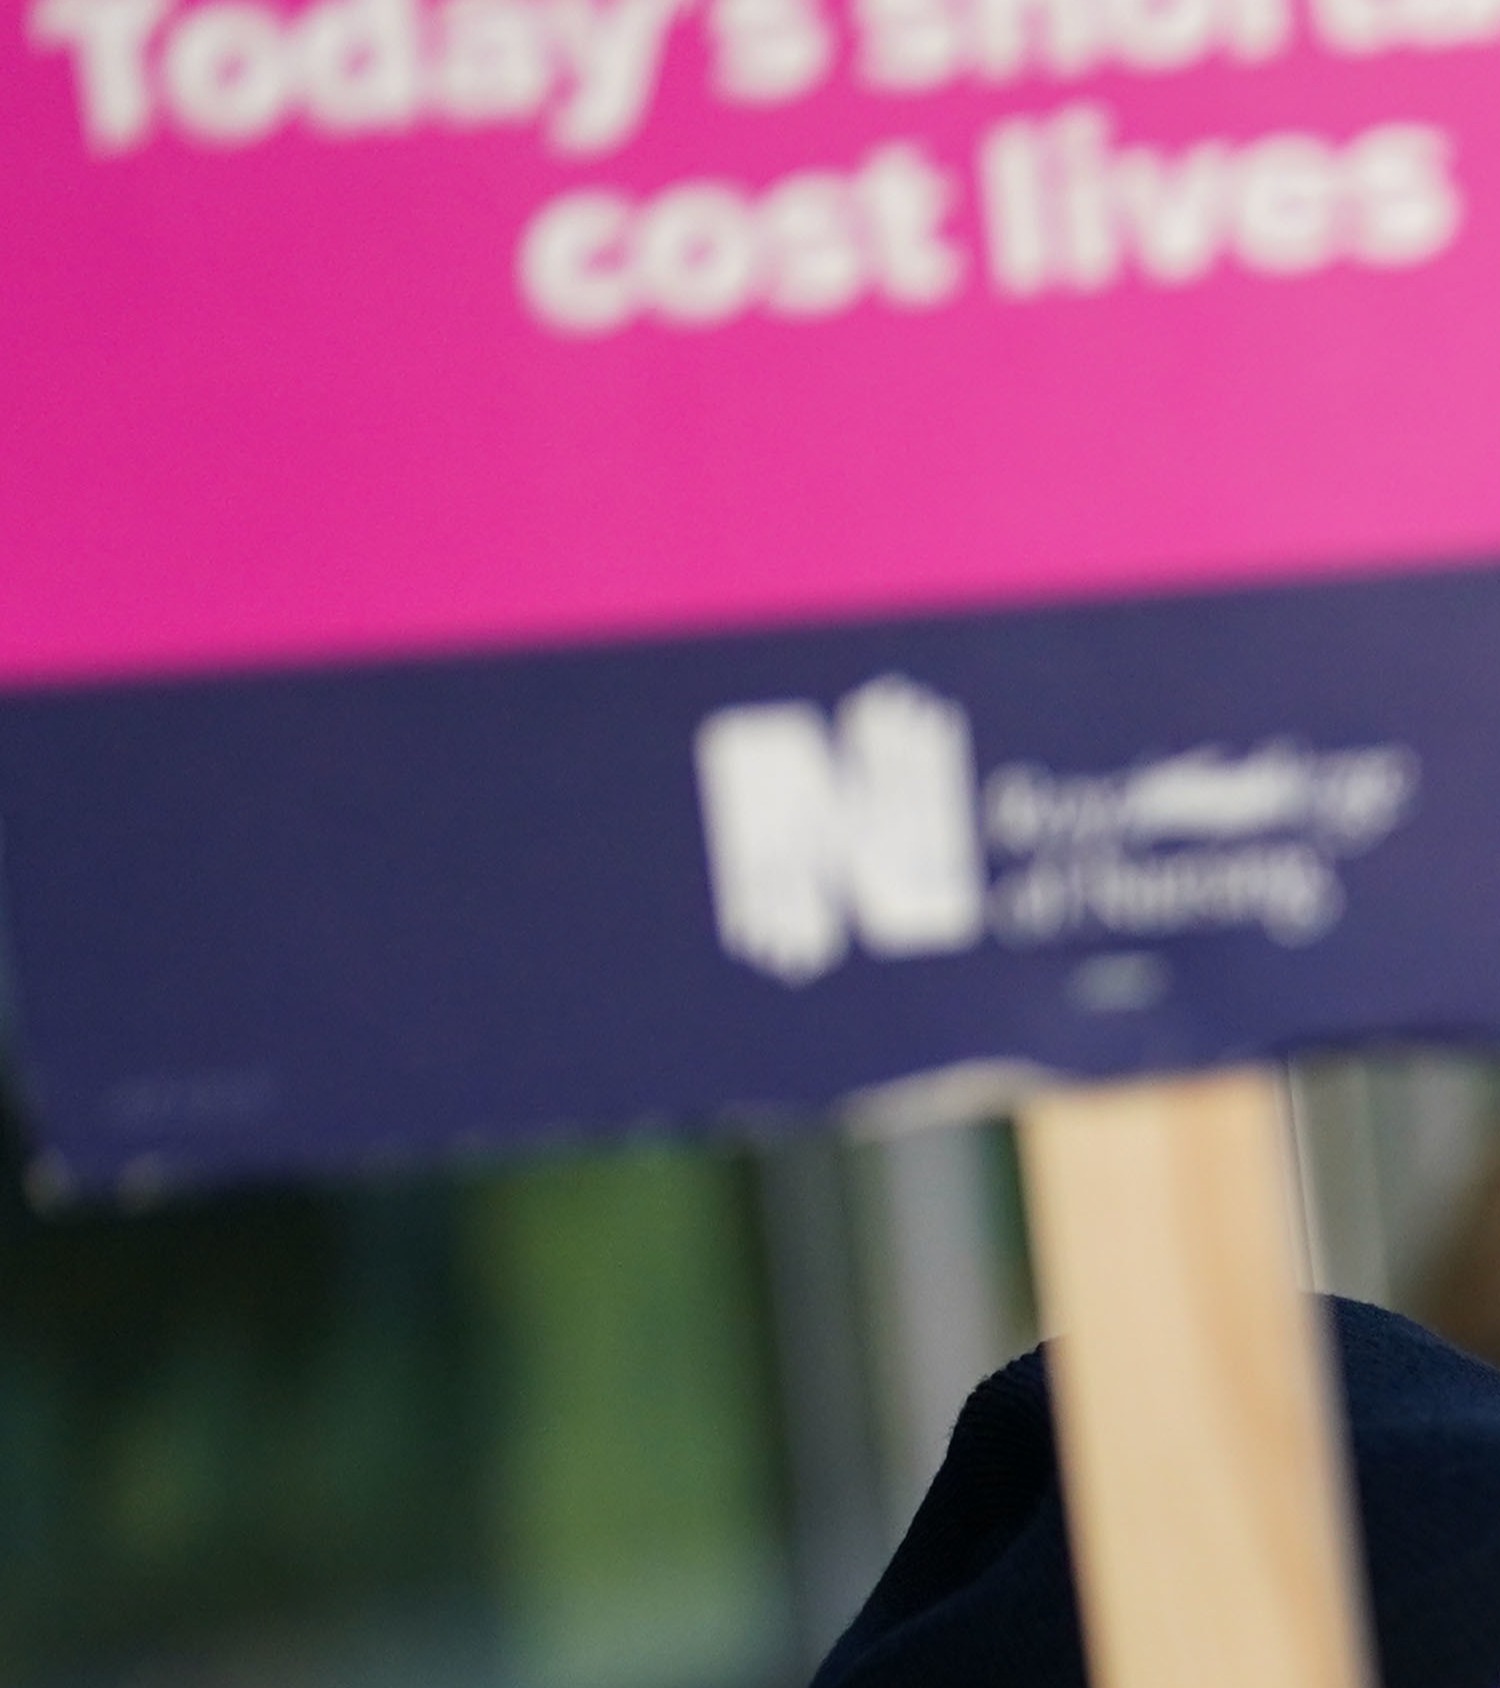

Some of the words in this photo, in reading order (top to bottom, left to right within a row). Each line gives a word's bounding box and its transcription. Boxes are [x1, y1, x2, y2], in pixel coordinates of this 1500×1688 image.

[34, 0, 834, 155] Todays
[518, 142, 965, 334] cost
[977, 102, 1466, 300] lives
